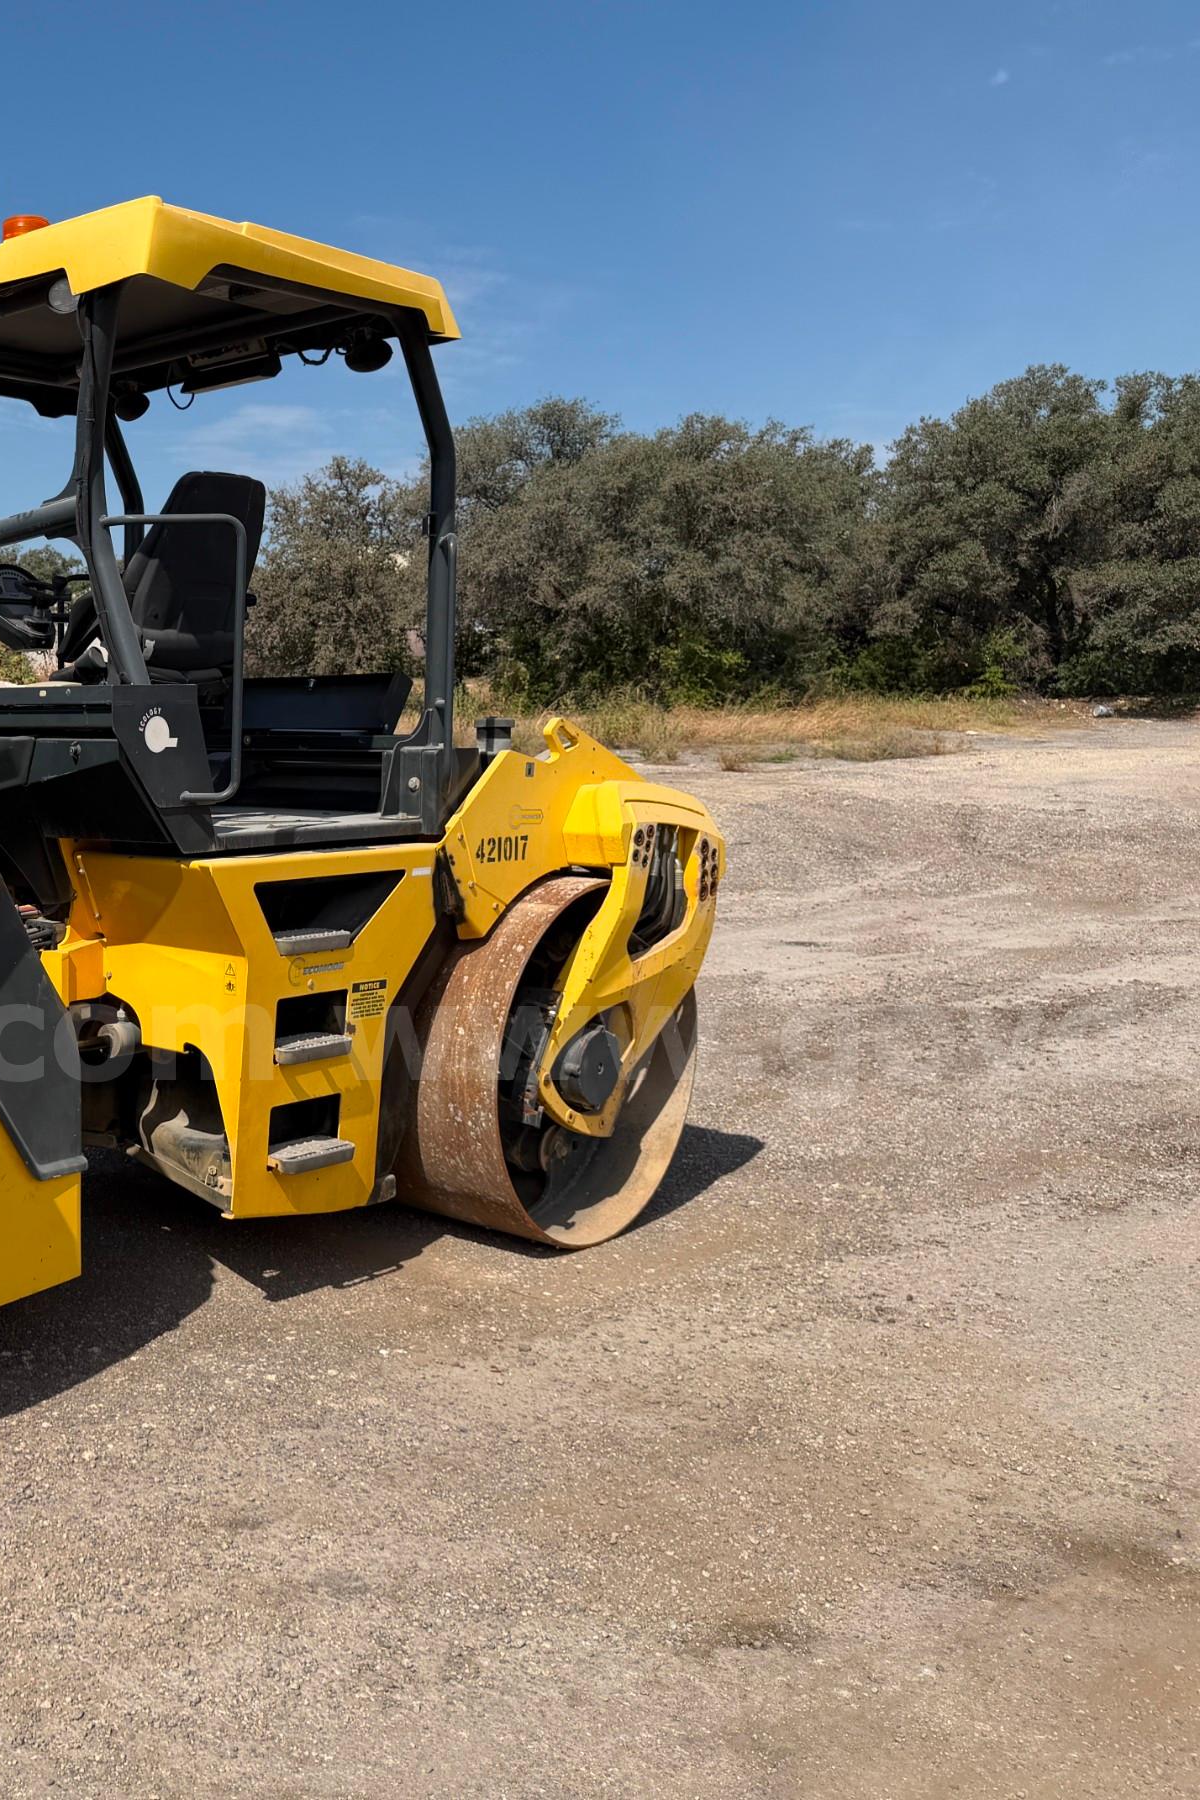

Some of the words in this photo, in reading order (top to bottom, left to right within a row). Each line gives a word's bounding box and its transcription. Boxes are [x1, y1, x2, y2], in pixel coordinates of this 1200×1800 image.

[138, 706, 162, 732] ECOLOGY
[475, 834, 529, 864] 421017
[359, 982, 380, 992] NOTICE
